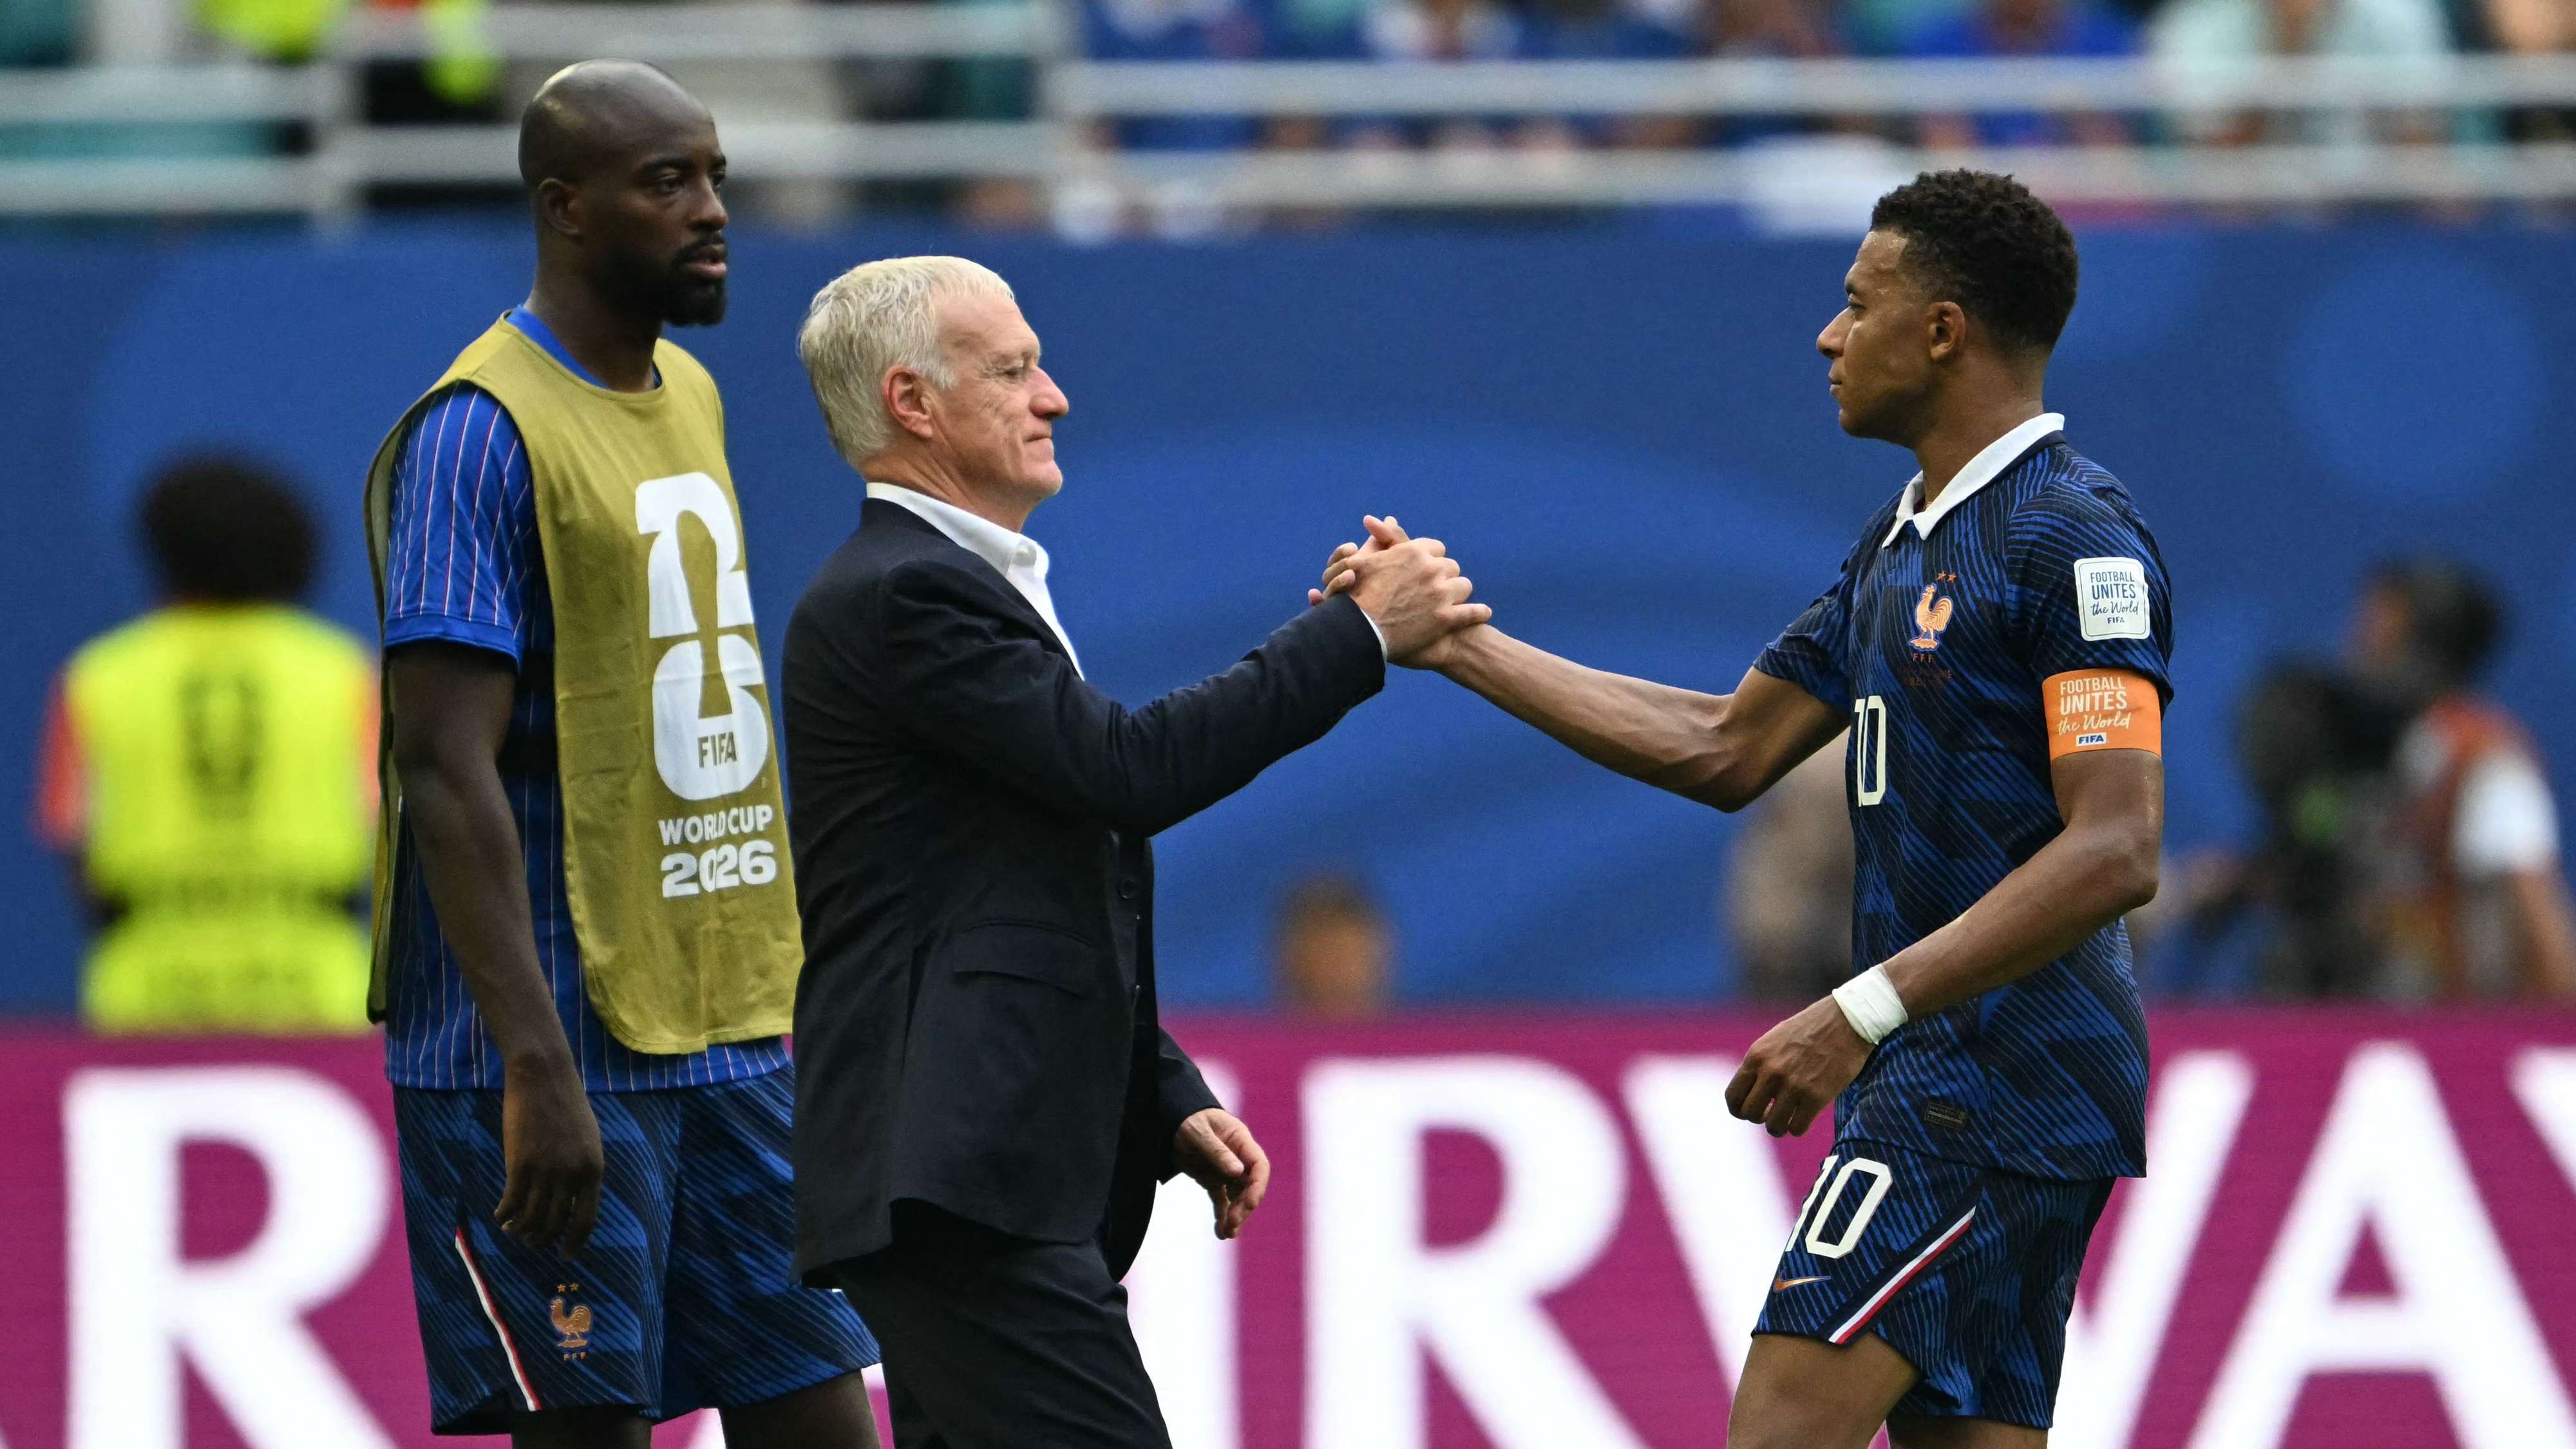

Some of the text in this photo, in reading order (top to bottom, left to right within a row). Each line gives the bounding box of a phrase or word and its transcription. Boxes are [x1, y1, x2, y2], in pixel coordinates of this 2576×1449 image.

[2090, 571, 2135, 583] FOOTBALL
[2091, 583, 2136, 600] UNITES
[2090, 600, 2139, 616] the World
[2061, 677, 2126, 696] FOOTBALL
[2061, 690, 2127, 715] UNITES
[2057, 710, 2132, 735] the World
[697, 732, 737, 768] FIFA
[1854, 695, 1886, 807] 10
[2078, 734, 2104, 744] FIFA
[658, 804, 773, 845] WORLD CUP
[661, 839, 777, 898] 2026
[1785, 1155, 1893, 1259] 10
